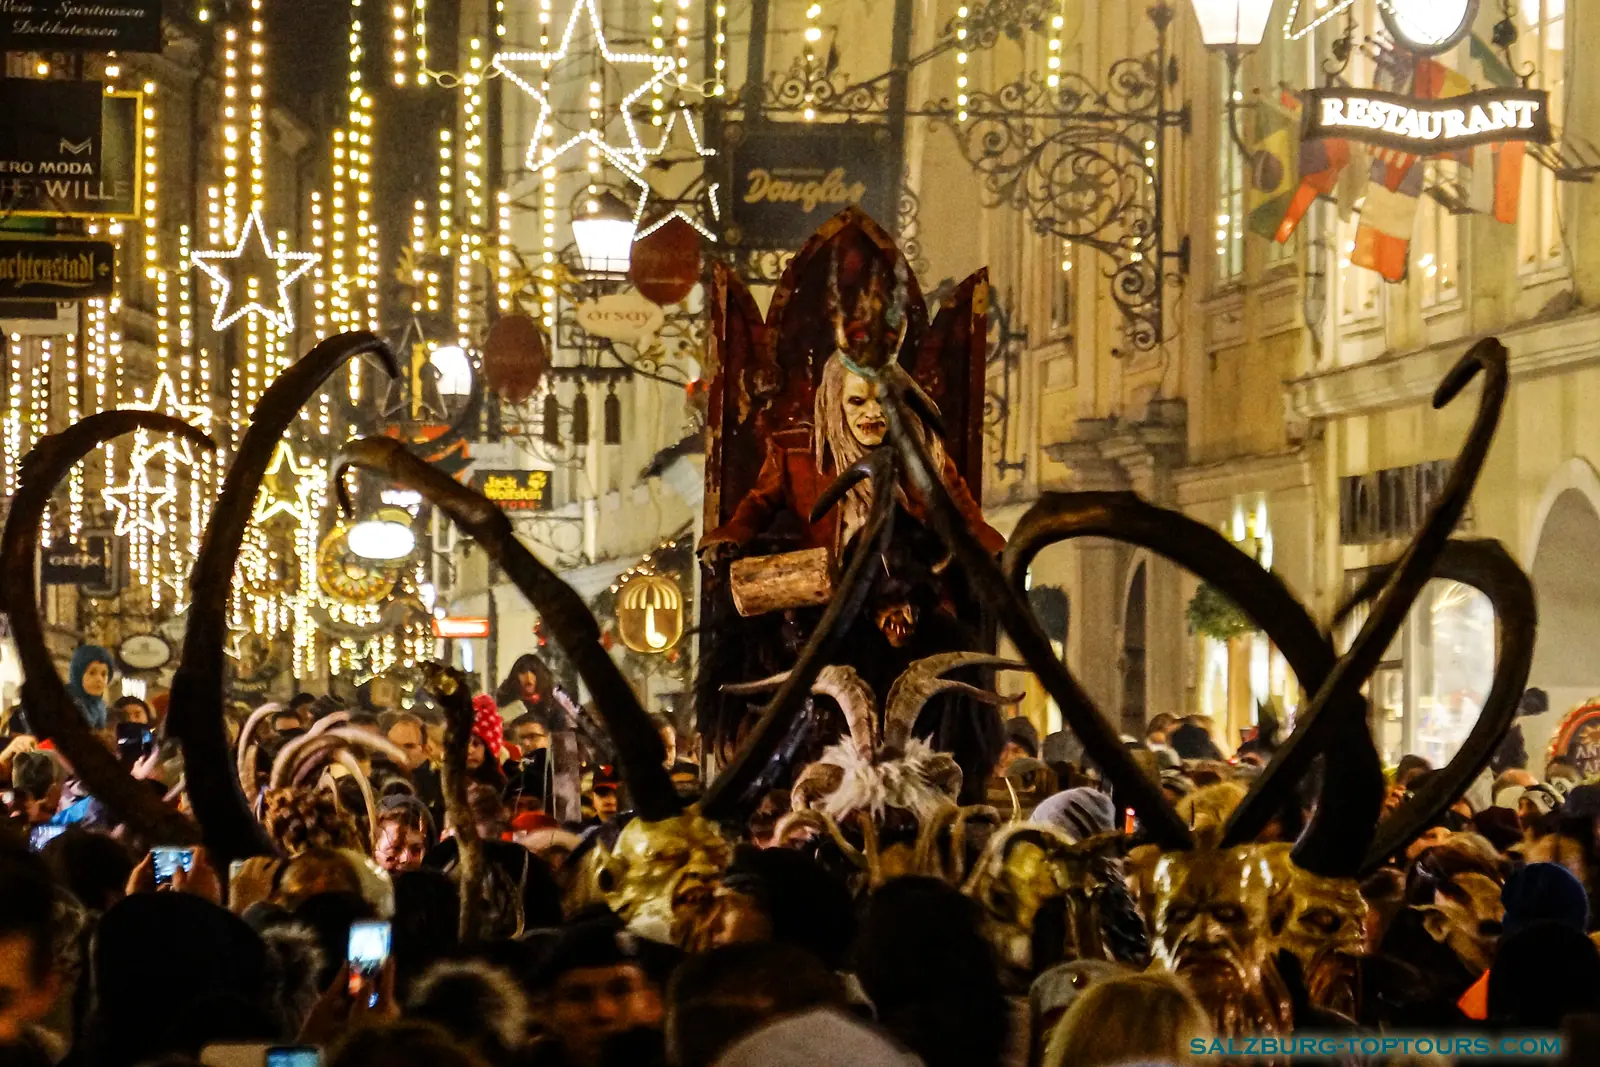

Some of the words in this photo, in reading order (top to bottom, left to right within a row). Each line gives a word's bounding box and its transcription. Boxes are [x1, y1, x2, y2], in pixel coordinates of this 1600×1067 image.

[54, 0, 146, 18] Spirituosen
[12, 20, 120, 36] Delikatessen
[1321, 98, 1540, 139] RESTAURANT
[39, 162, 93, 175] MODA
[45, 180, 128, 200] WILLE
[587, 311, 653, 328] orsay
